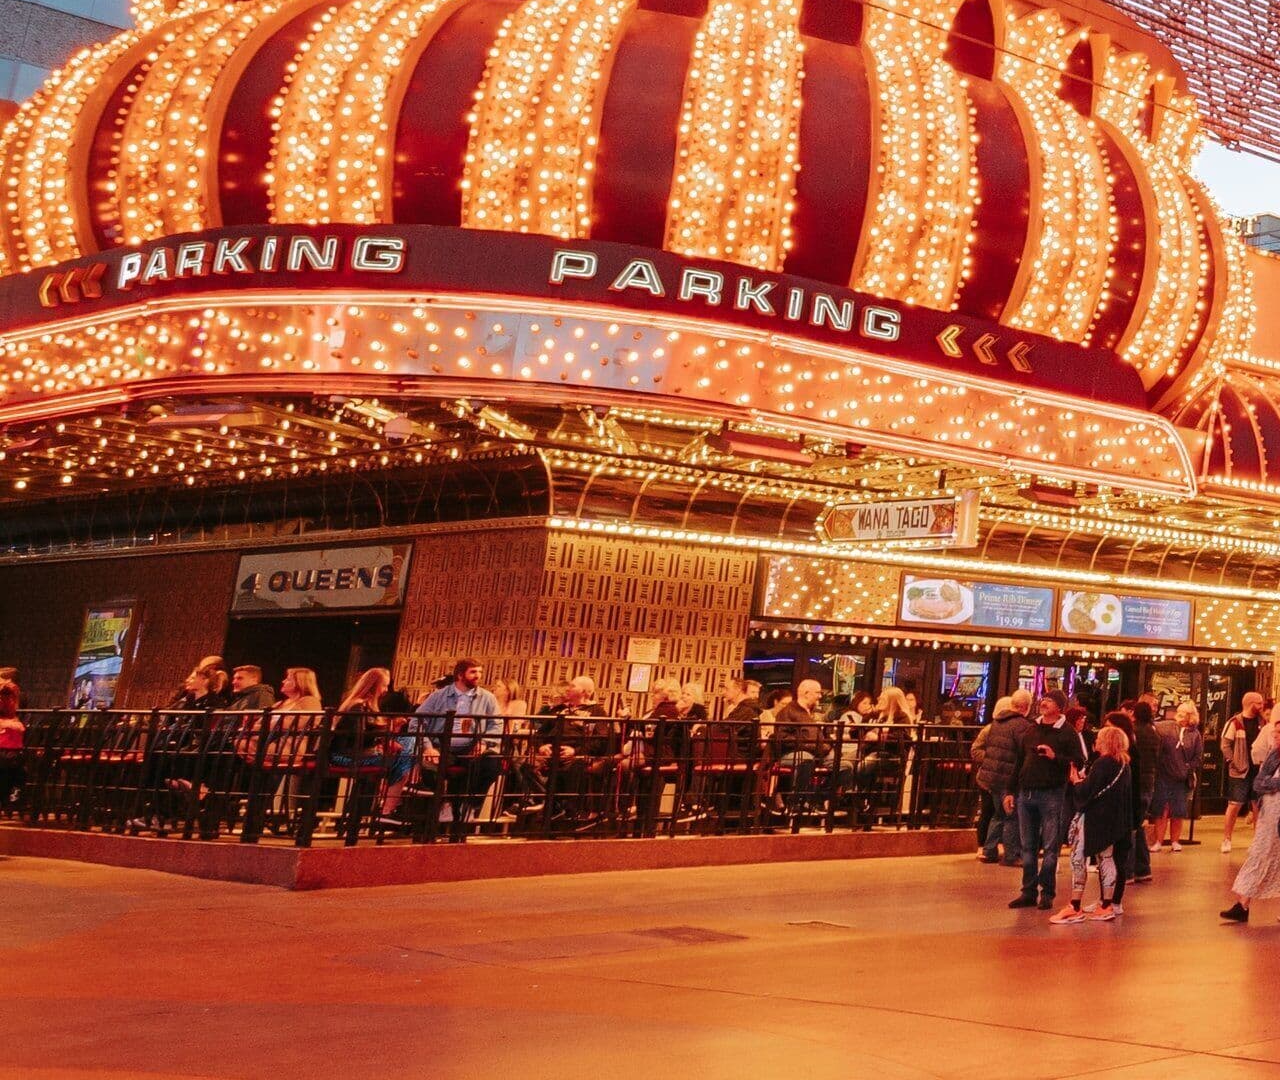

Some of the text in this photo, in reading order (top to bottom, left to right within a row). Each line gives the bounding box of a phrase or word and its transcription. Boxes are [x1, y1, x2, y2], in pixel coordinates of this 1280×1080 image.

[117, 235, 406, 291] PARKING
[549, 250, 902, 342] PARKING
[858, 505, 930, 530] WANA TACO
[240, 564, 395, 593] 4 QUEENS
[1003, 593, 1017, 603] Rib
[995, 615, 1024, 627] $19.99
